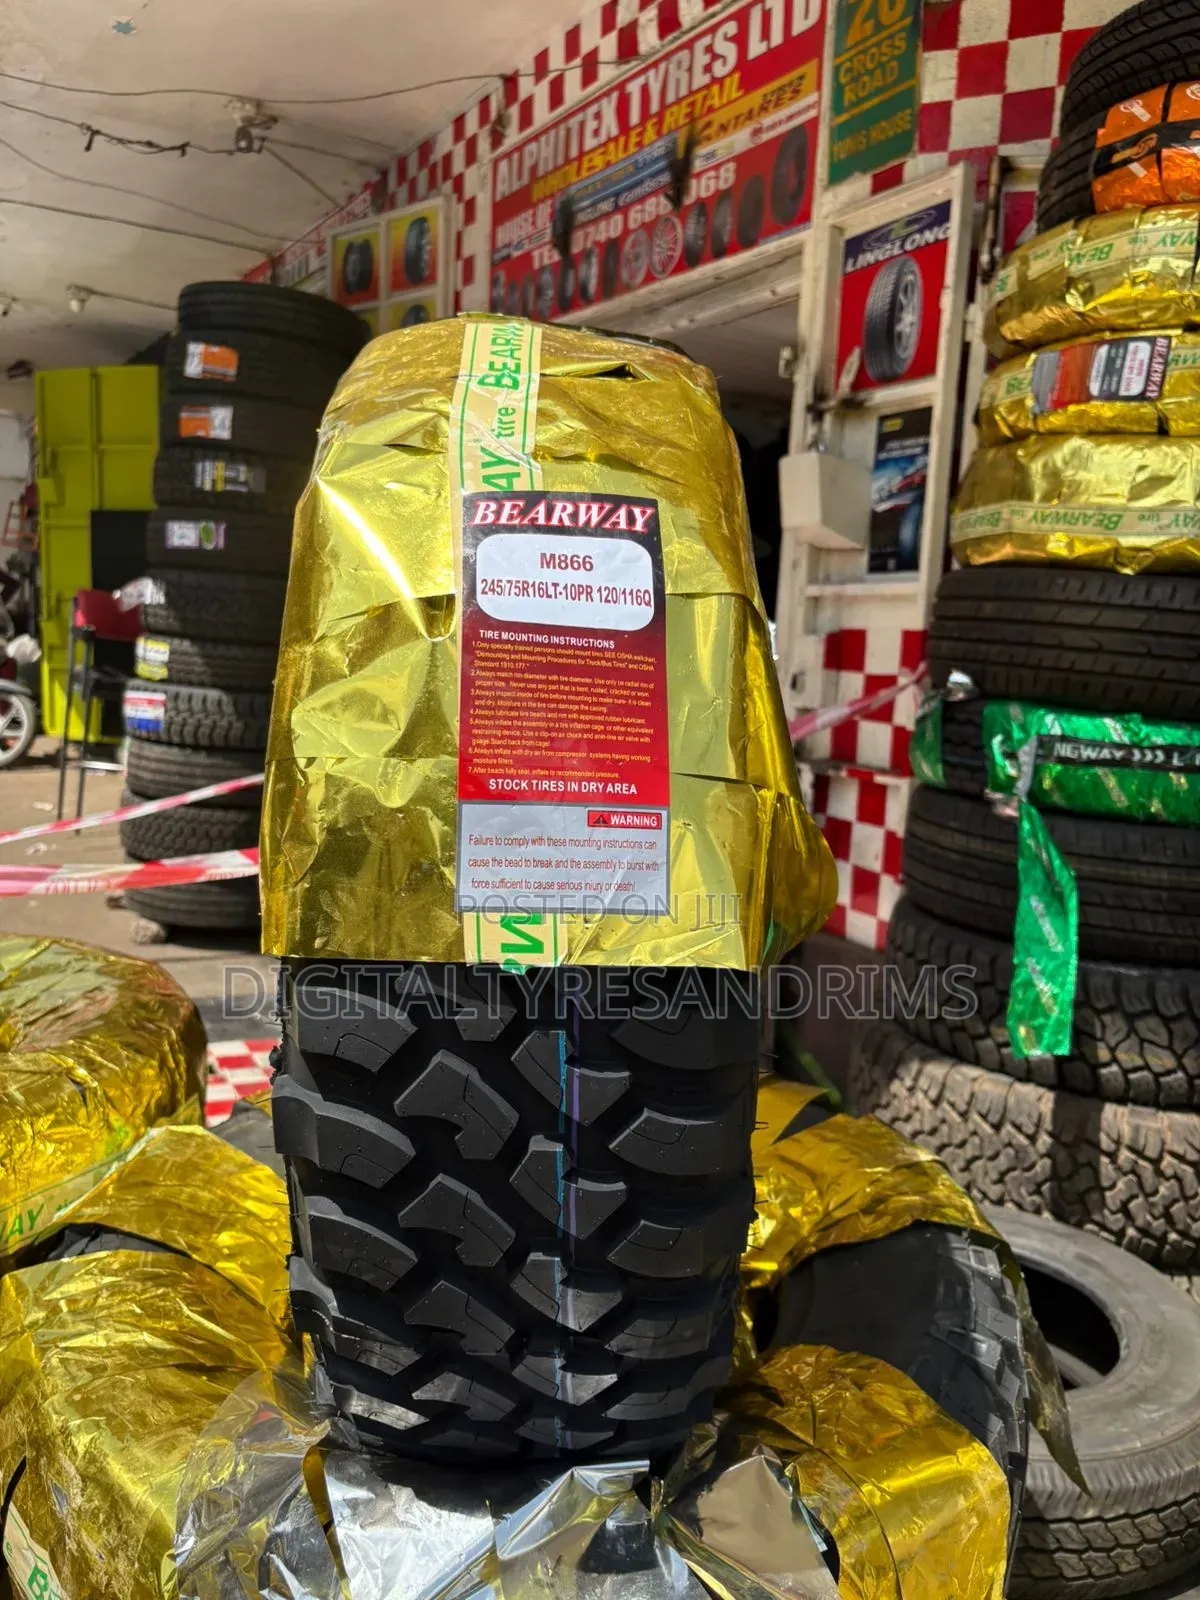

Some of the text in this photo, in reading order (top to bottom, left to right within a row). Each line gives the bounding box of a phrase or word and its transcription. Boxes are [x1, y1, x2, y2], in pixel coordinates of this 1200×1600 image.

[839, 32, 907, 84] CROSS
[843, 60, 899, 107] ROAD
[496, 92, 619, 201] ALPHITEX
[626, 20, 738, 123] TYRES
[747, 0, 822, 60] LTD
[662, 71, 744, 135] RETAIL
[845, 222, 951, 273] LINGLONG
[1145, 337, 1169, 398] BEARWAY
[469, 499, 655, 534] BEARWAY
[1029, 510, 1125, 531] BEARWAY
[540, 553, 594, 572] M866
[480, 579, 652, 608] 245/75R16LT-10PR 120/116Q
[479, 629, 615, 649] TIRE MOUNTING INSTRUCTIONS
[489, 779, 637, 794] STOCK TIRES IN DRY AREA
[610, 813, 657, 827] WARNING
[468, 834, 656, 850] Failure to comply with these mounting instructions can
[468, 857, 659, 872] cause the bead to break and the assembly to burst with
[472, 878, 490, 889] force
[491, 878, 523, 889] sufficient
[525, 879, 532, 889] to
[533, 880, 554, 890] cause
[556, 880, 582, 890] serious
[584, 880, 603, 893] injury
[614, 880, 636, 892] death!
[0, 1203, 45, 1244] AY
